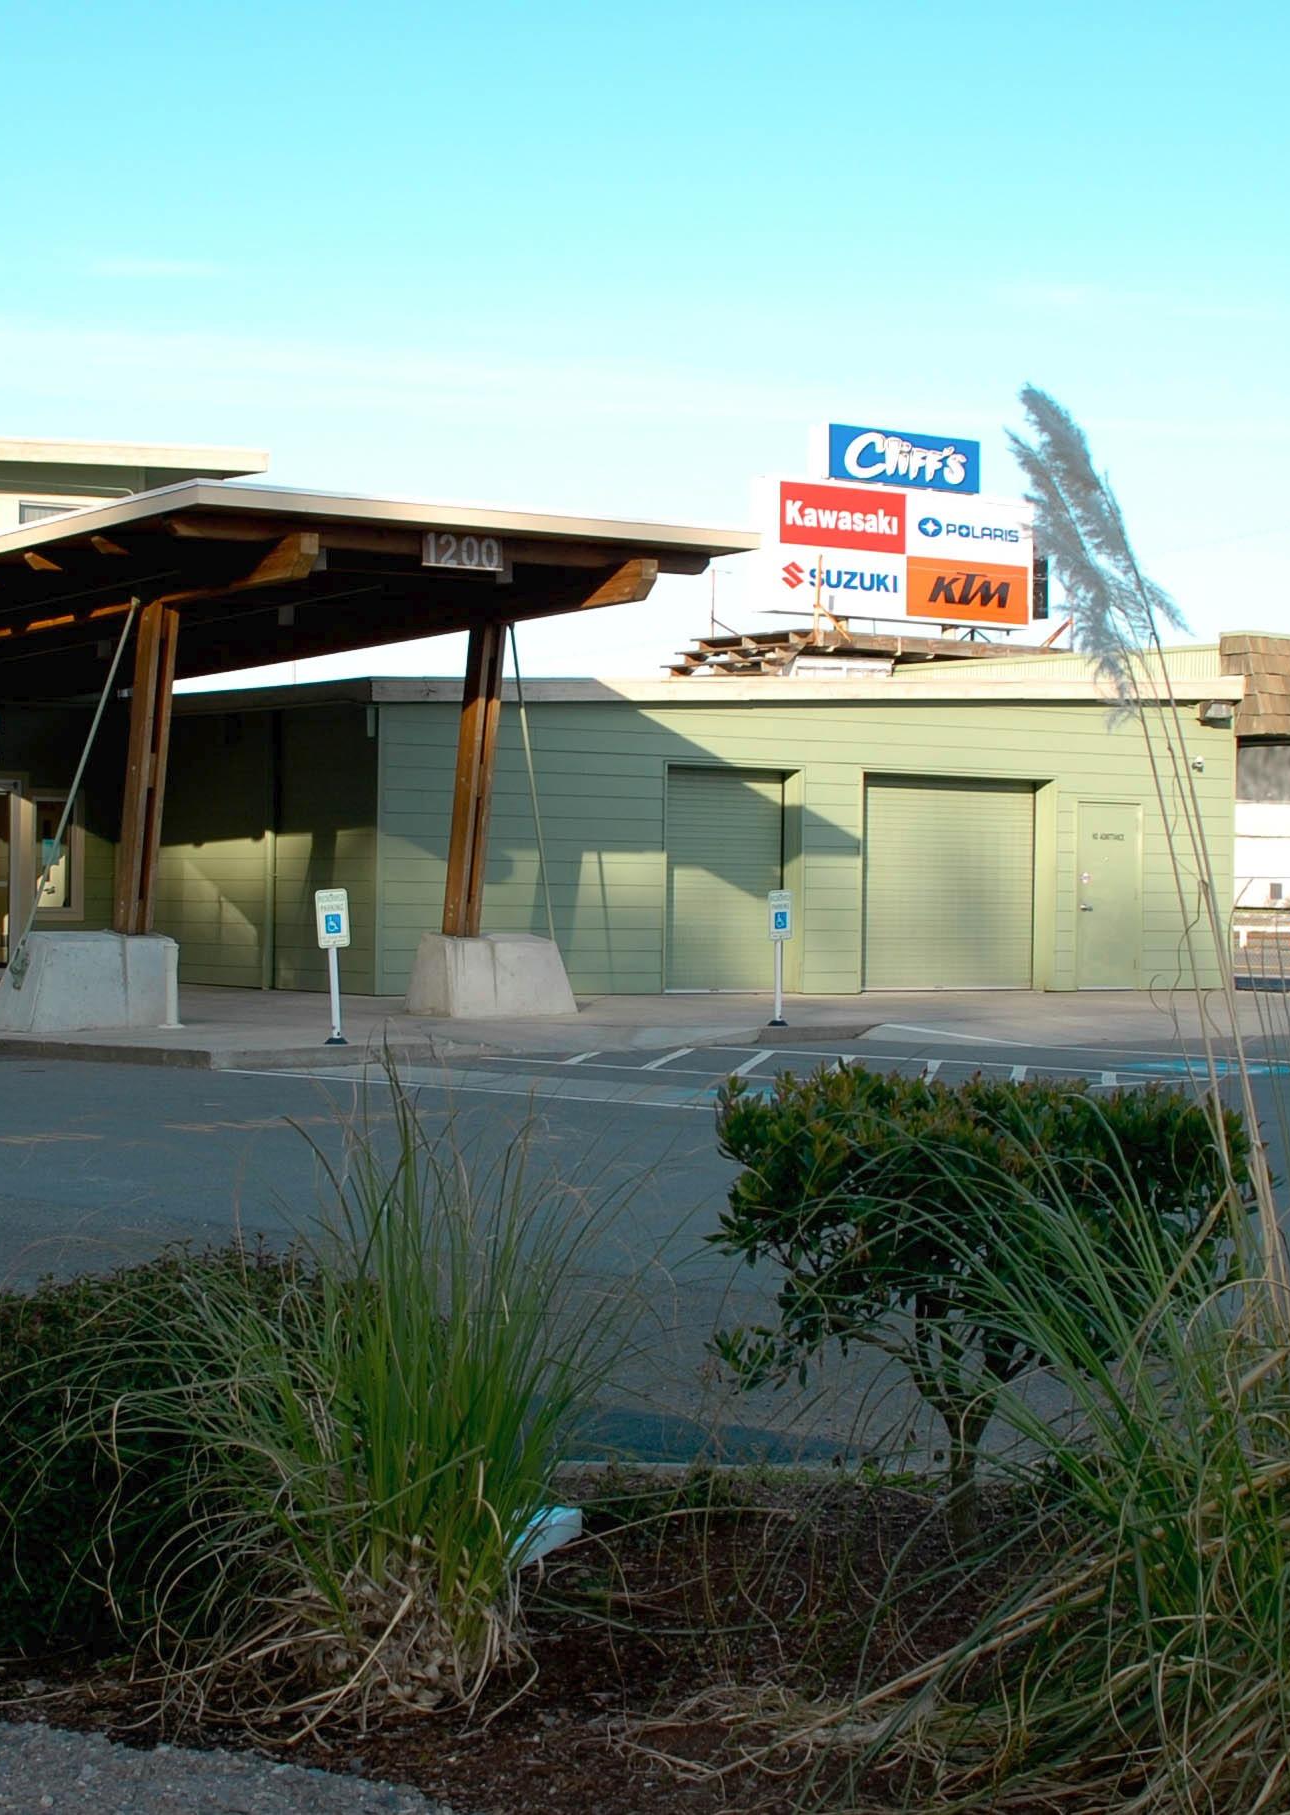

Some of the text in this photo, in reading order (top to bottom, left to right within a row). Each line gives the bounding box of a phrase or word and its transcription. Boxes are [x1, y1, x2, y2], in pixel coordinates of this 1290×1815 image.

[784, 500, 899, 536] Kawasaki
[947, 524, 1019, 542] POLARIS
[427, 532, 499, 569] 1200
[809, 569, 898, 593] SUZUKI
[928, 572, 1011, 609] KTM
